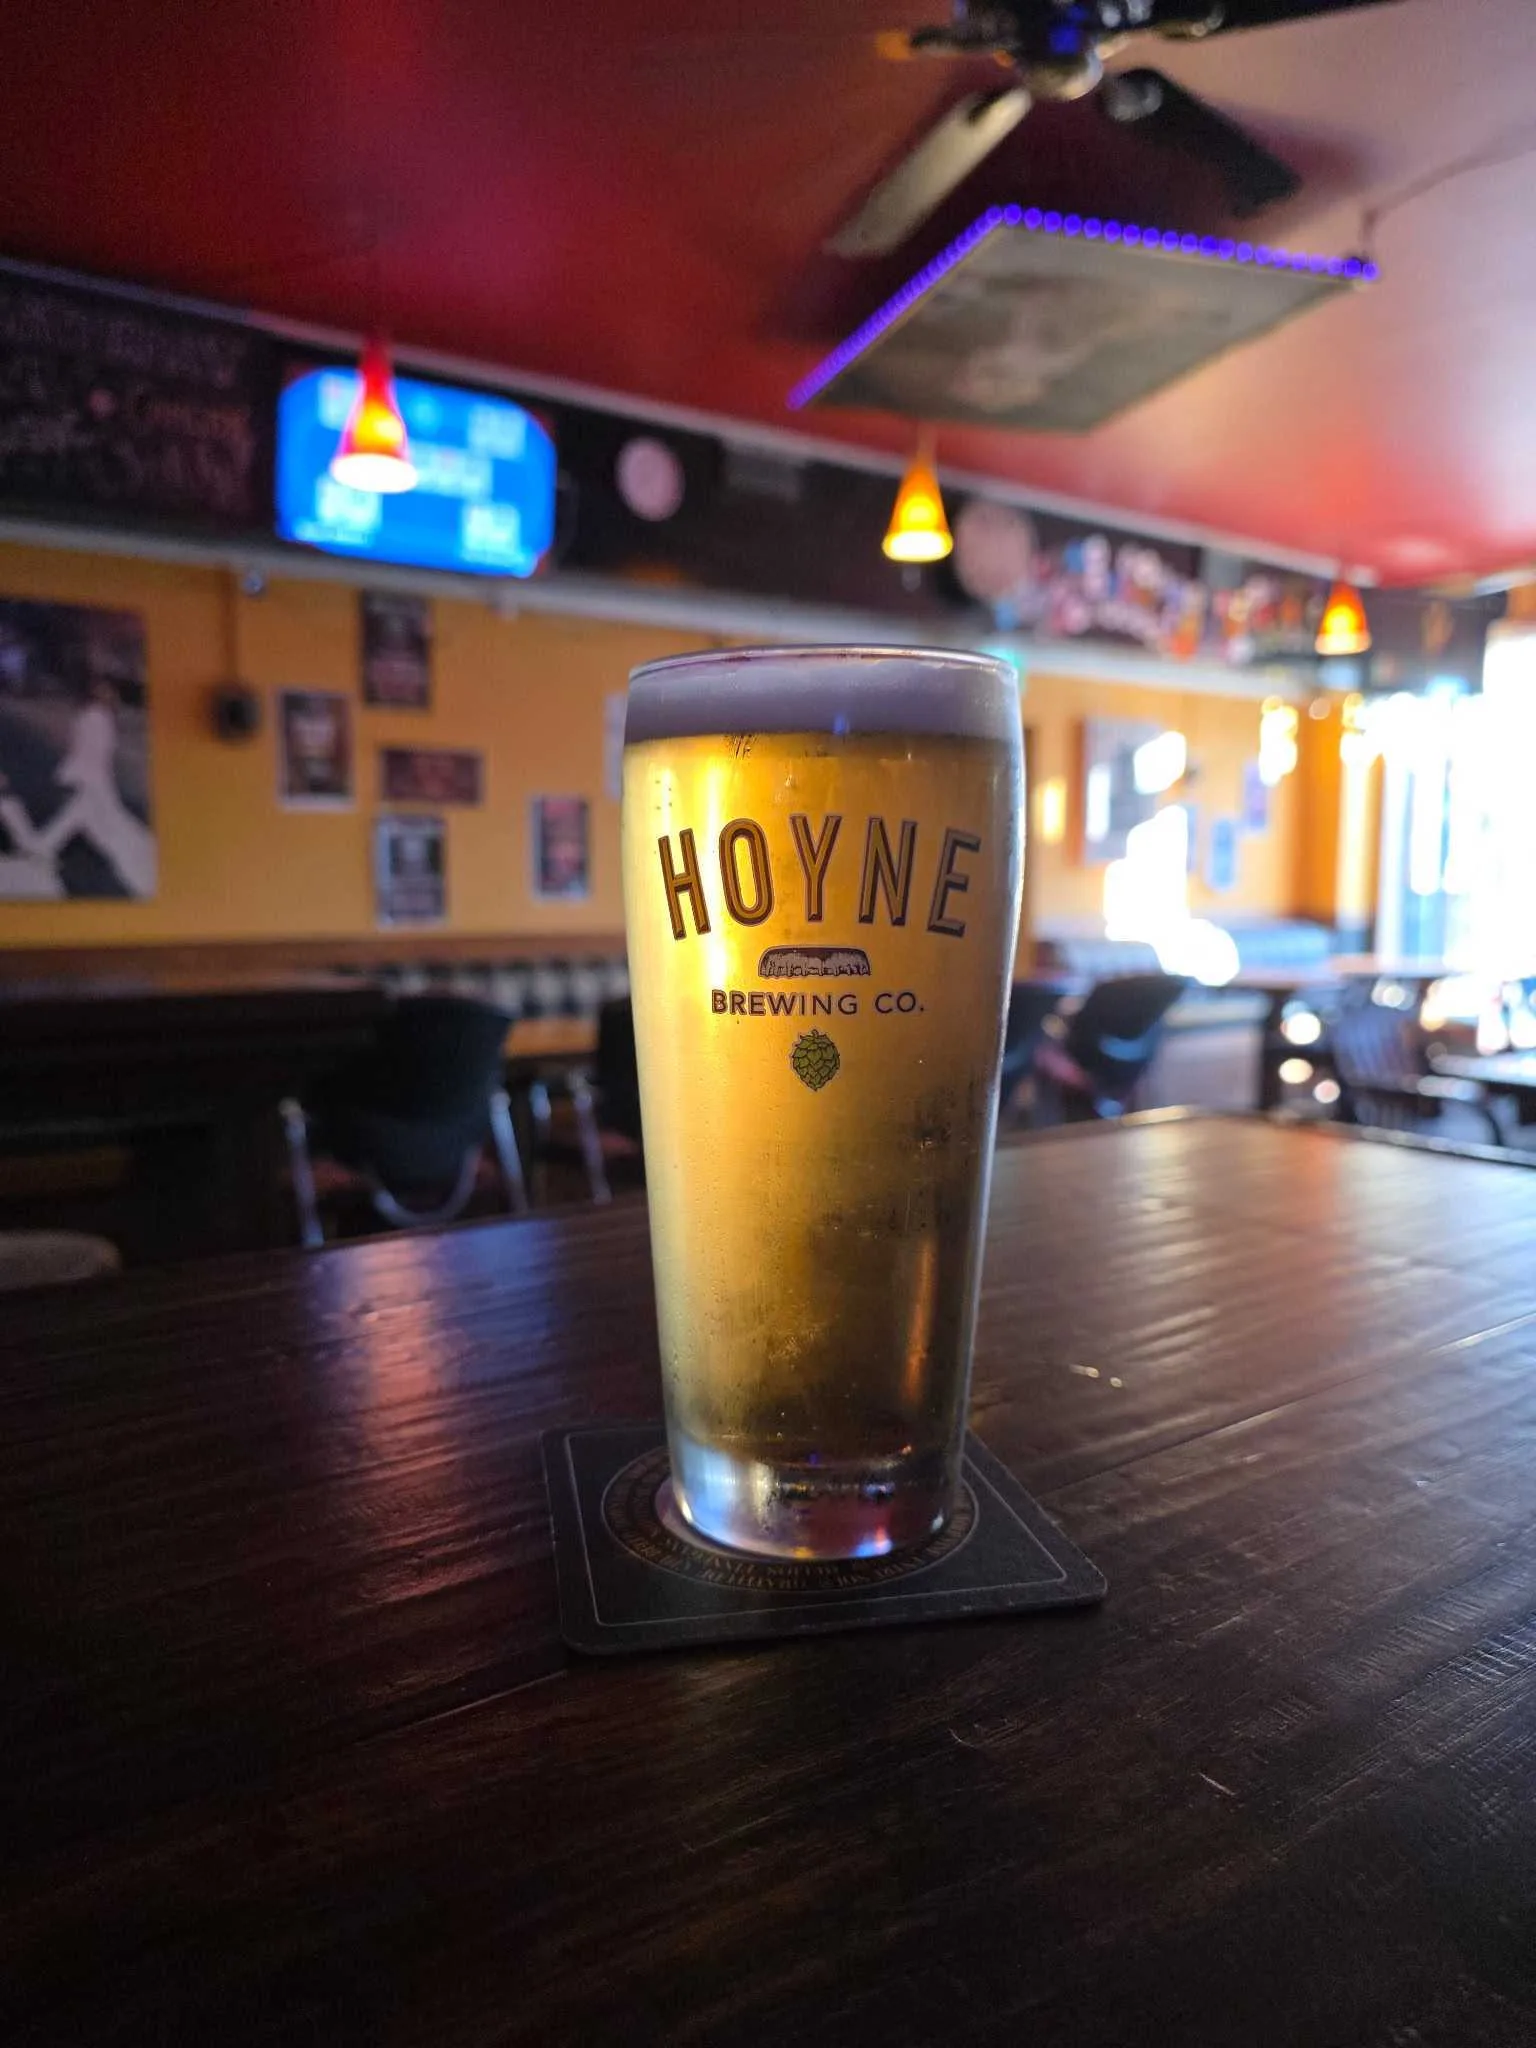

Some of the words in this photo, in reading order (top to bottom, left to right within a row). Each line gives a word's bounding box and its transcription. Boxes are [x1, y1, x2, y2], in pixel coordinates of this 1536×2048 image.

[658, 813, 982, 940] HOYNE
[711, 989, 858, 1016] BREWING
[874, 991, 925, 1015] CO.
